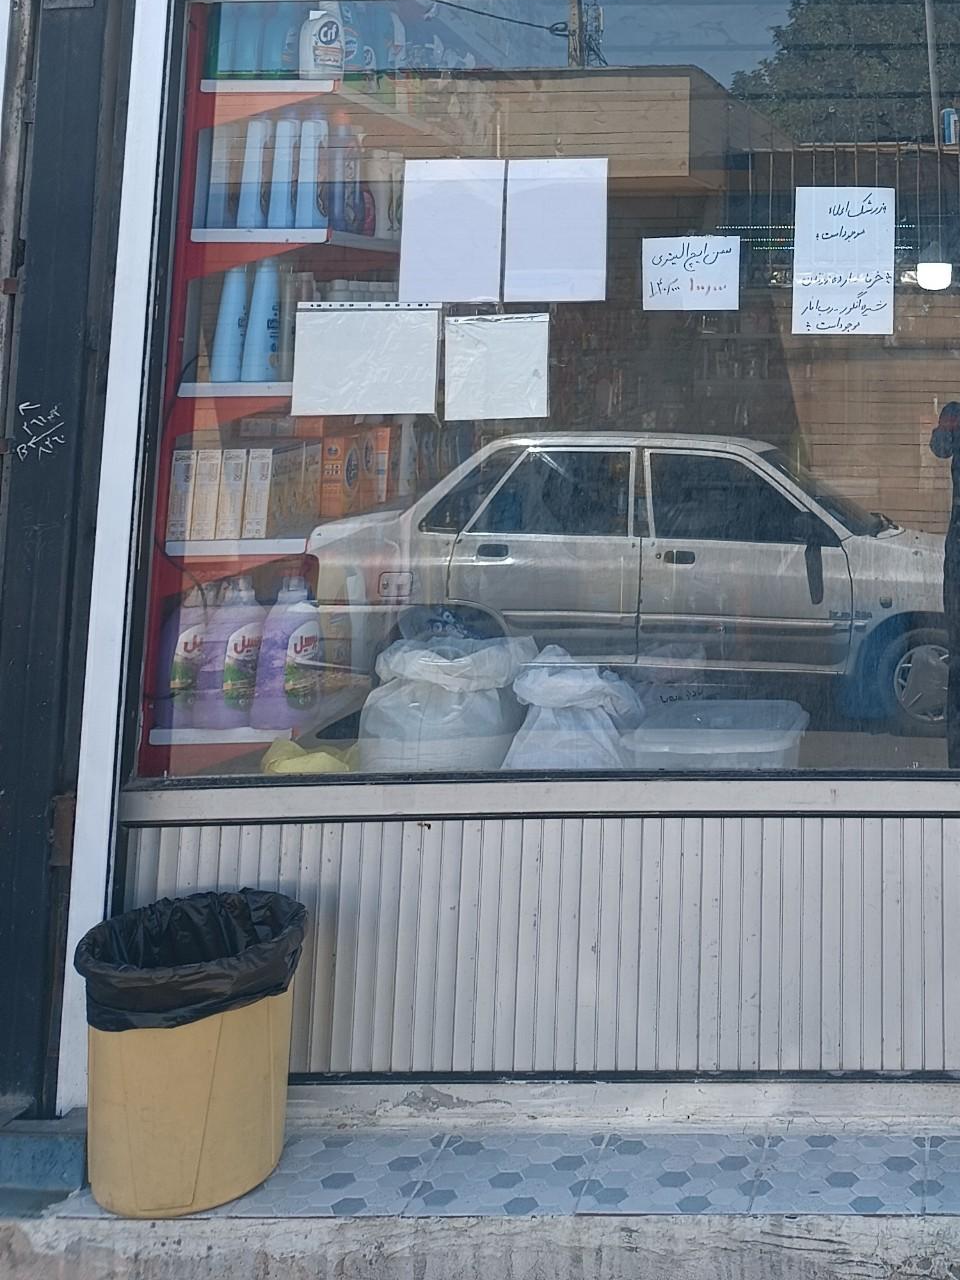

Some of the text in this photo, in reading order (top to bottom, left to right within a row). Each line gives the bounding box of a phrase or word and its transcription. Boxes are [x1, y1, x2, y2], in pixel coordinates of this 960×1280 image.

[320, 24, 337, 42] Cif
[821, 225, 865, 242] موجود است
[816, 317, 861, 333] موجود است
